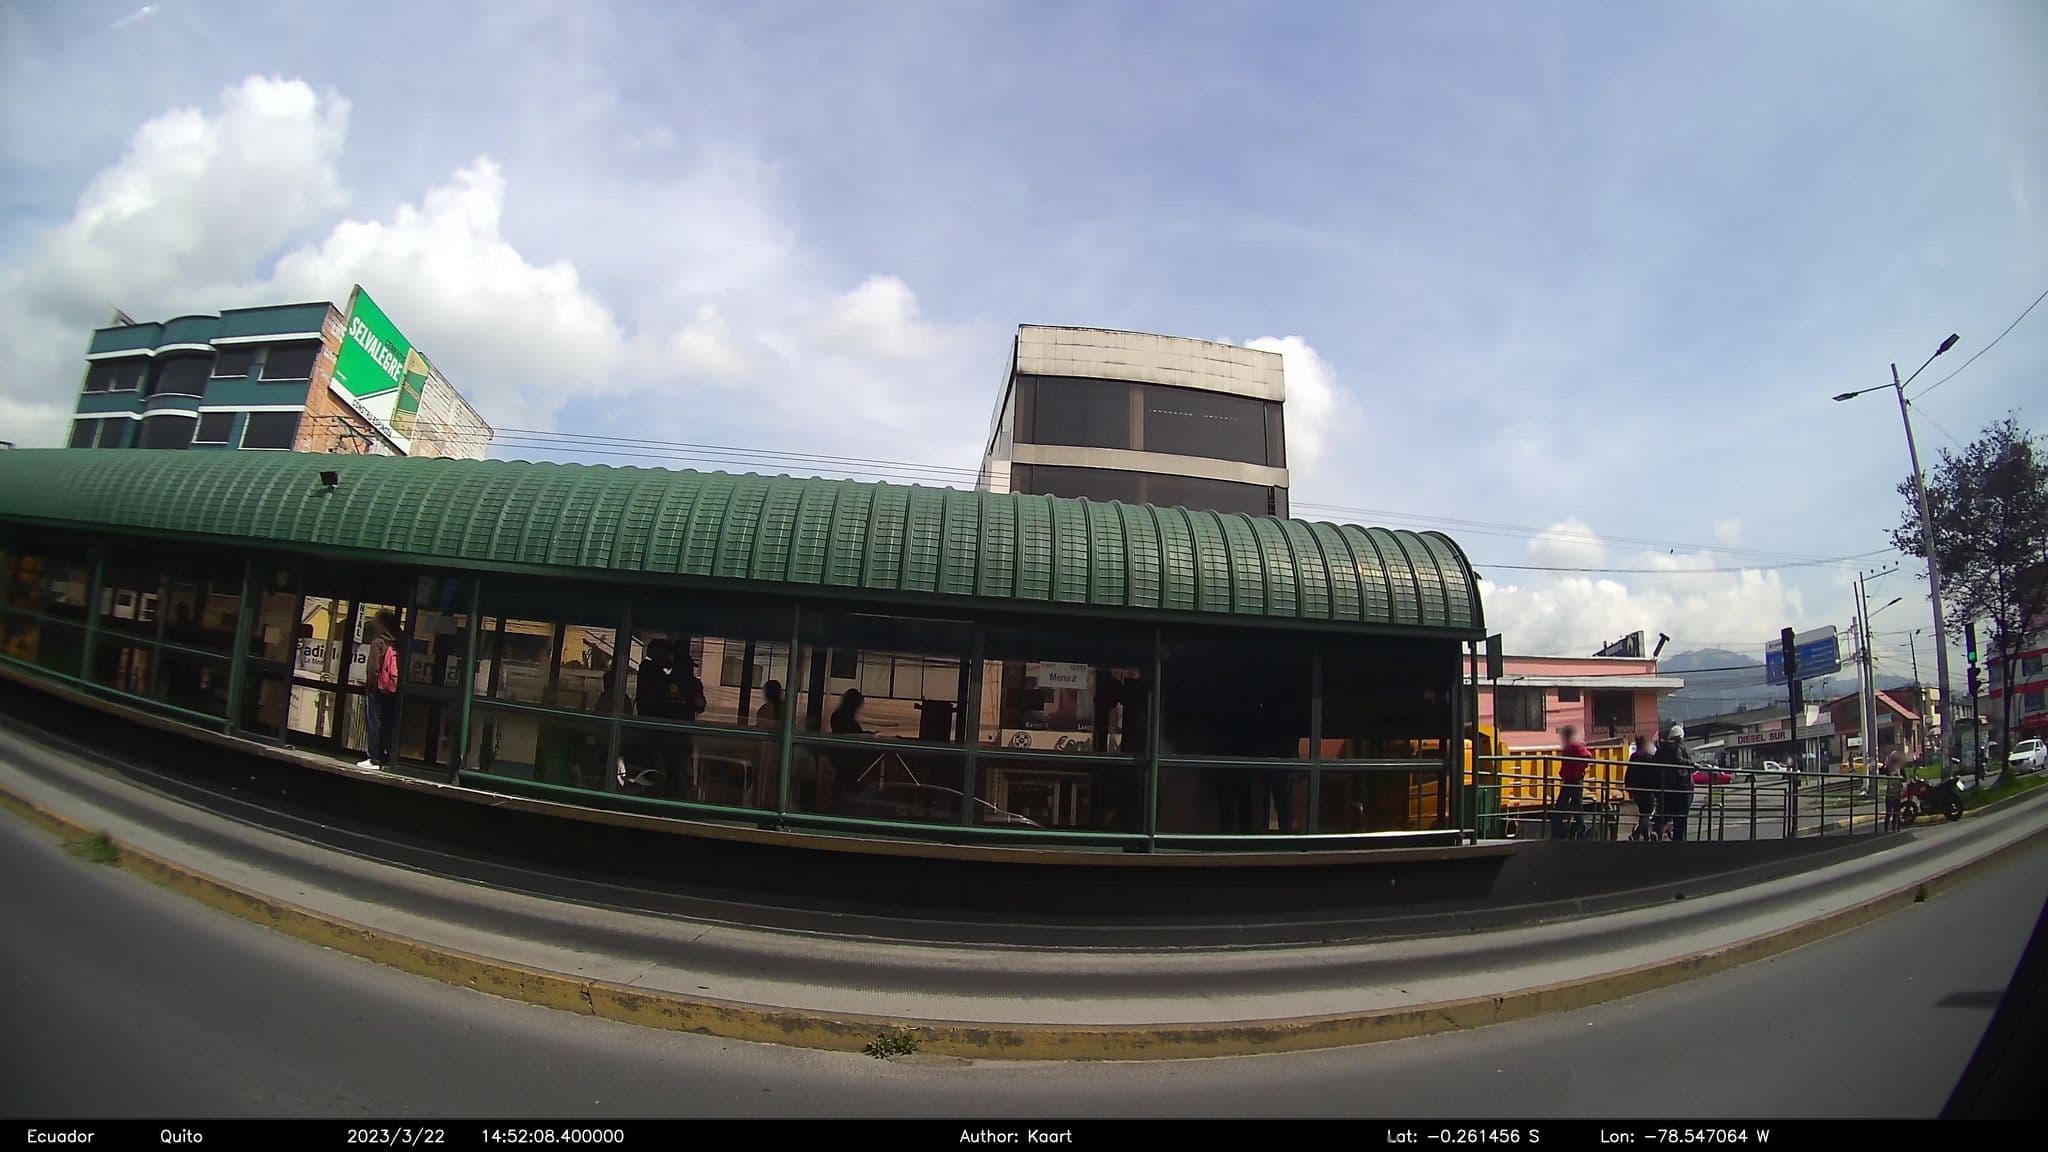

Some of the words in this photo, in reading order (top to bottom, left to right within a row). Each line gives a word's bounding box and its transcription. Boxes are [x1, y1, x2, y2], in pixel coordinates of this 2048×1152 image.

[349, 316, 403, 382] SELVALEGRE
[1737, 732, 1766, 745] DIESEL
[1769, 730, 1786, 740] SUR
